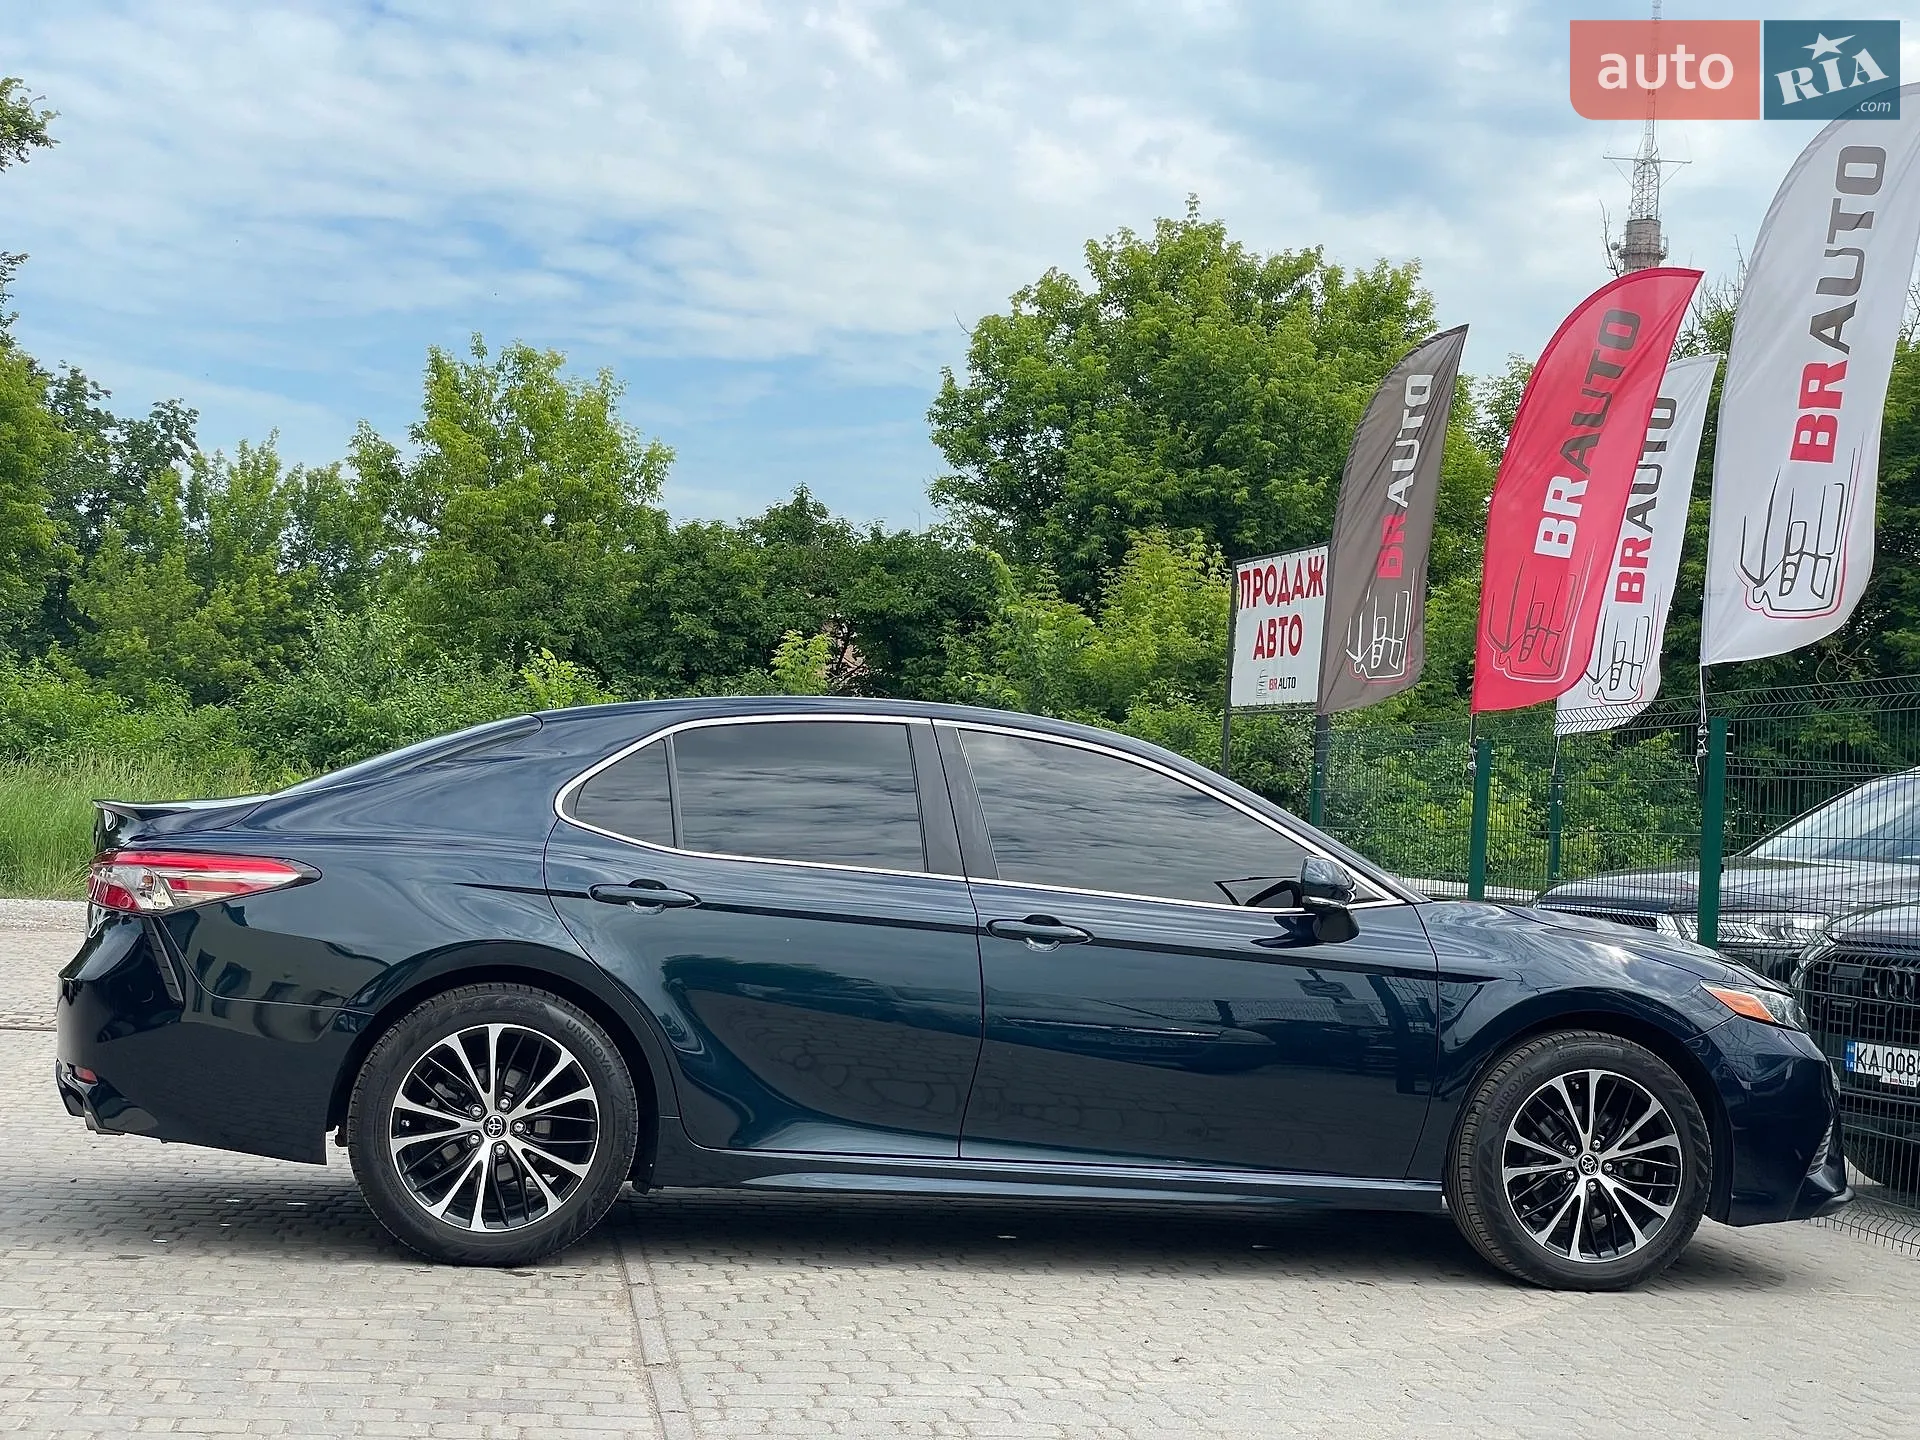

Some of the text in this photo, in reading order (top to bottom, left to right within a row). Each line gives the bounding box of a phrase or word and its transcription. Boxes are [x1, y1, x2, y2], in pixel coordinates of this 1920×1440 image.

[1239, 554, 1325, 609] ПРОДАЖ
[1253, 614, 1303, 661] АВТО
[566, 1019, 618, 1081] UNIROYAL
[1885, 1051, 1920, 1076] 008
